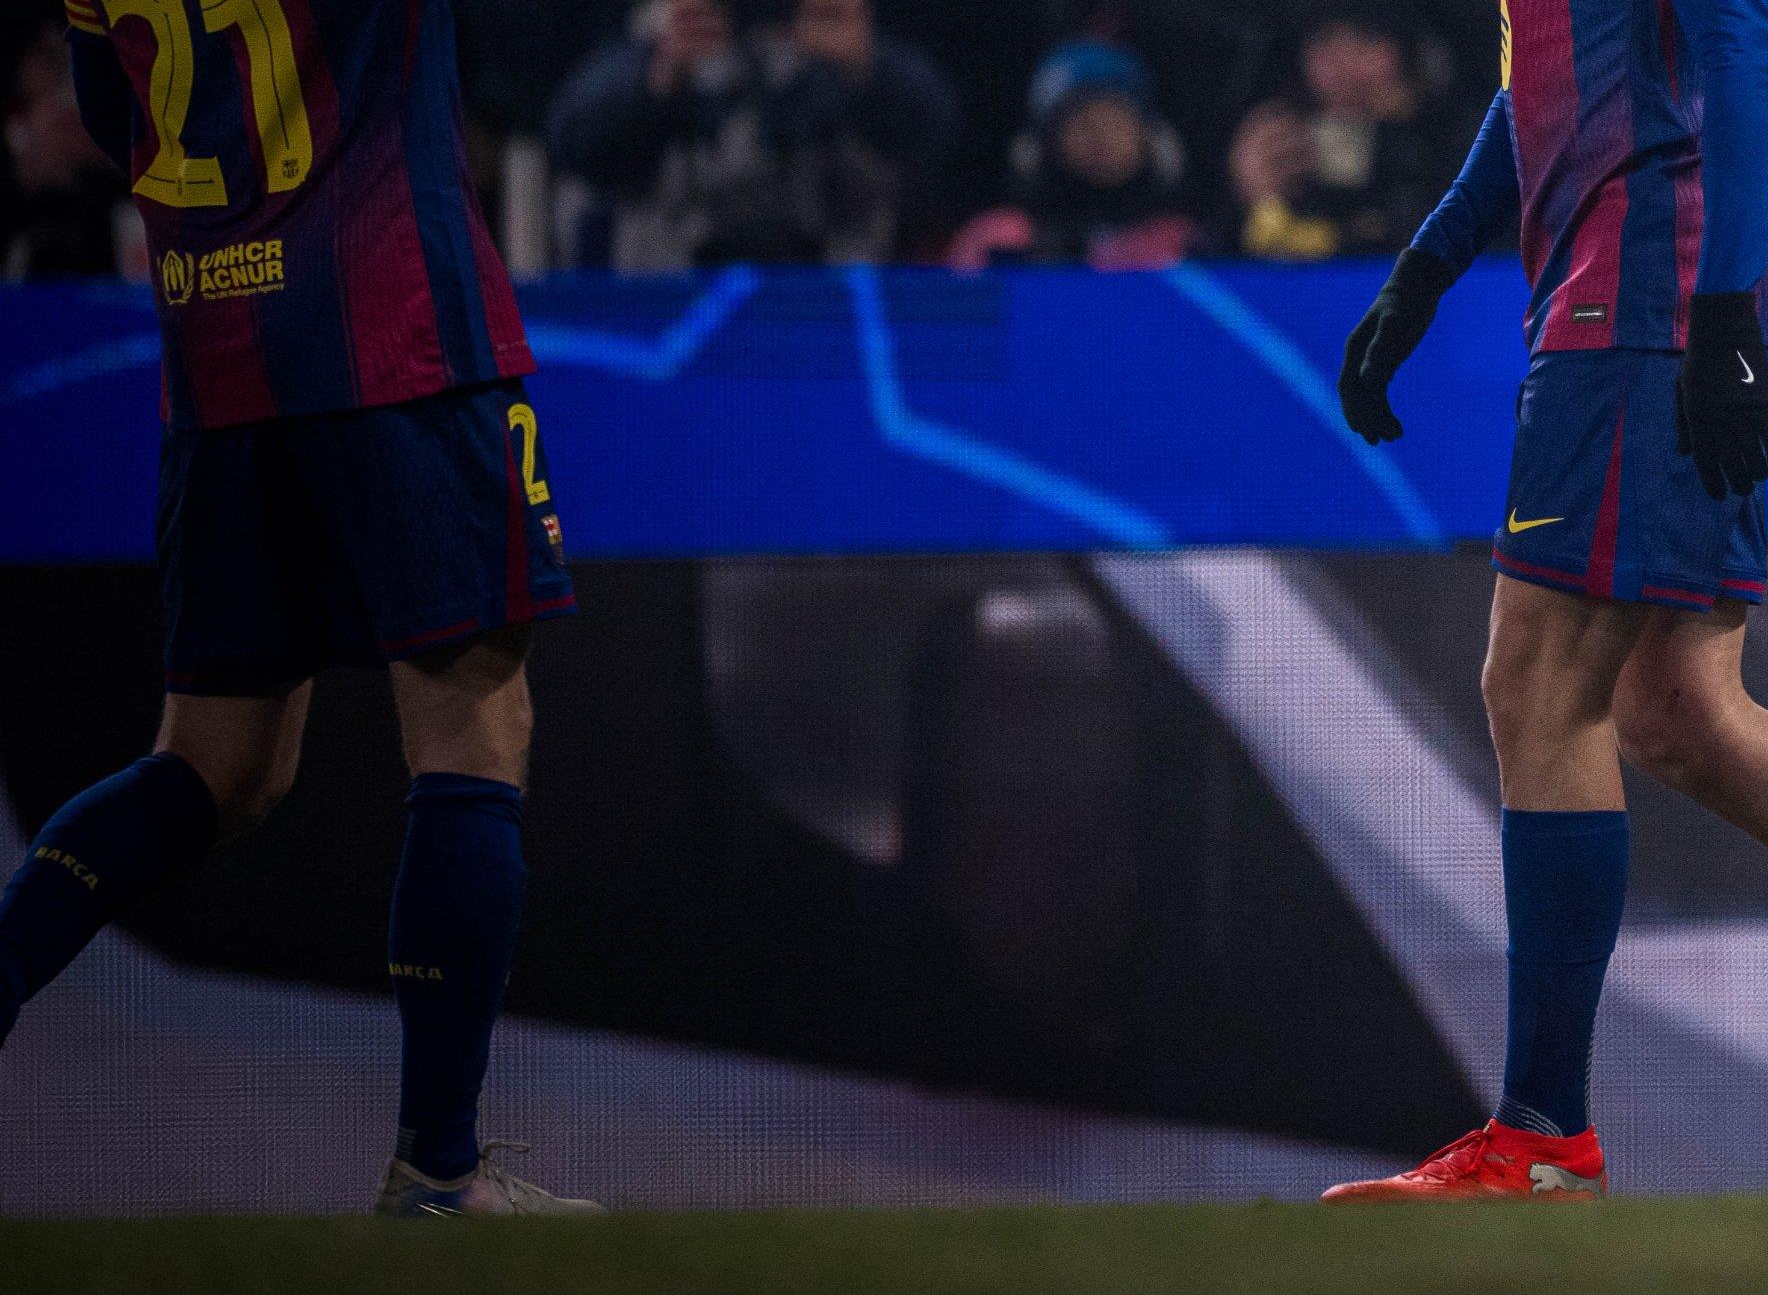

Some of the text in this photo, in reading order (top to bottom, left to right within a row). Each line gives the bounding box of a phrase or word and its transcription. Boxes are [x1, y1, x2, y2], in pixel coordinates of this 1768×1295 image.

[198, 239, 283, 271] UNHCR
[199, 259, 284, 292] ACNUR
[506, 402, 551, 506] 2
